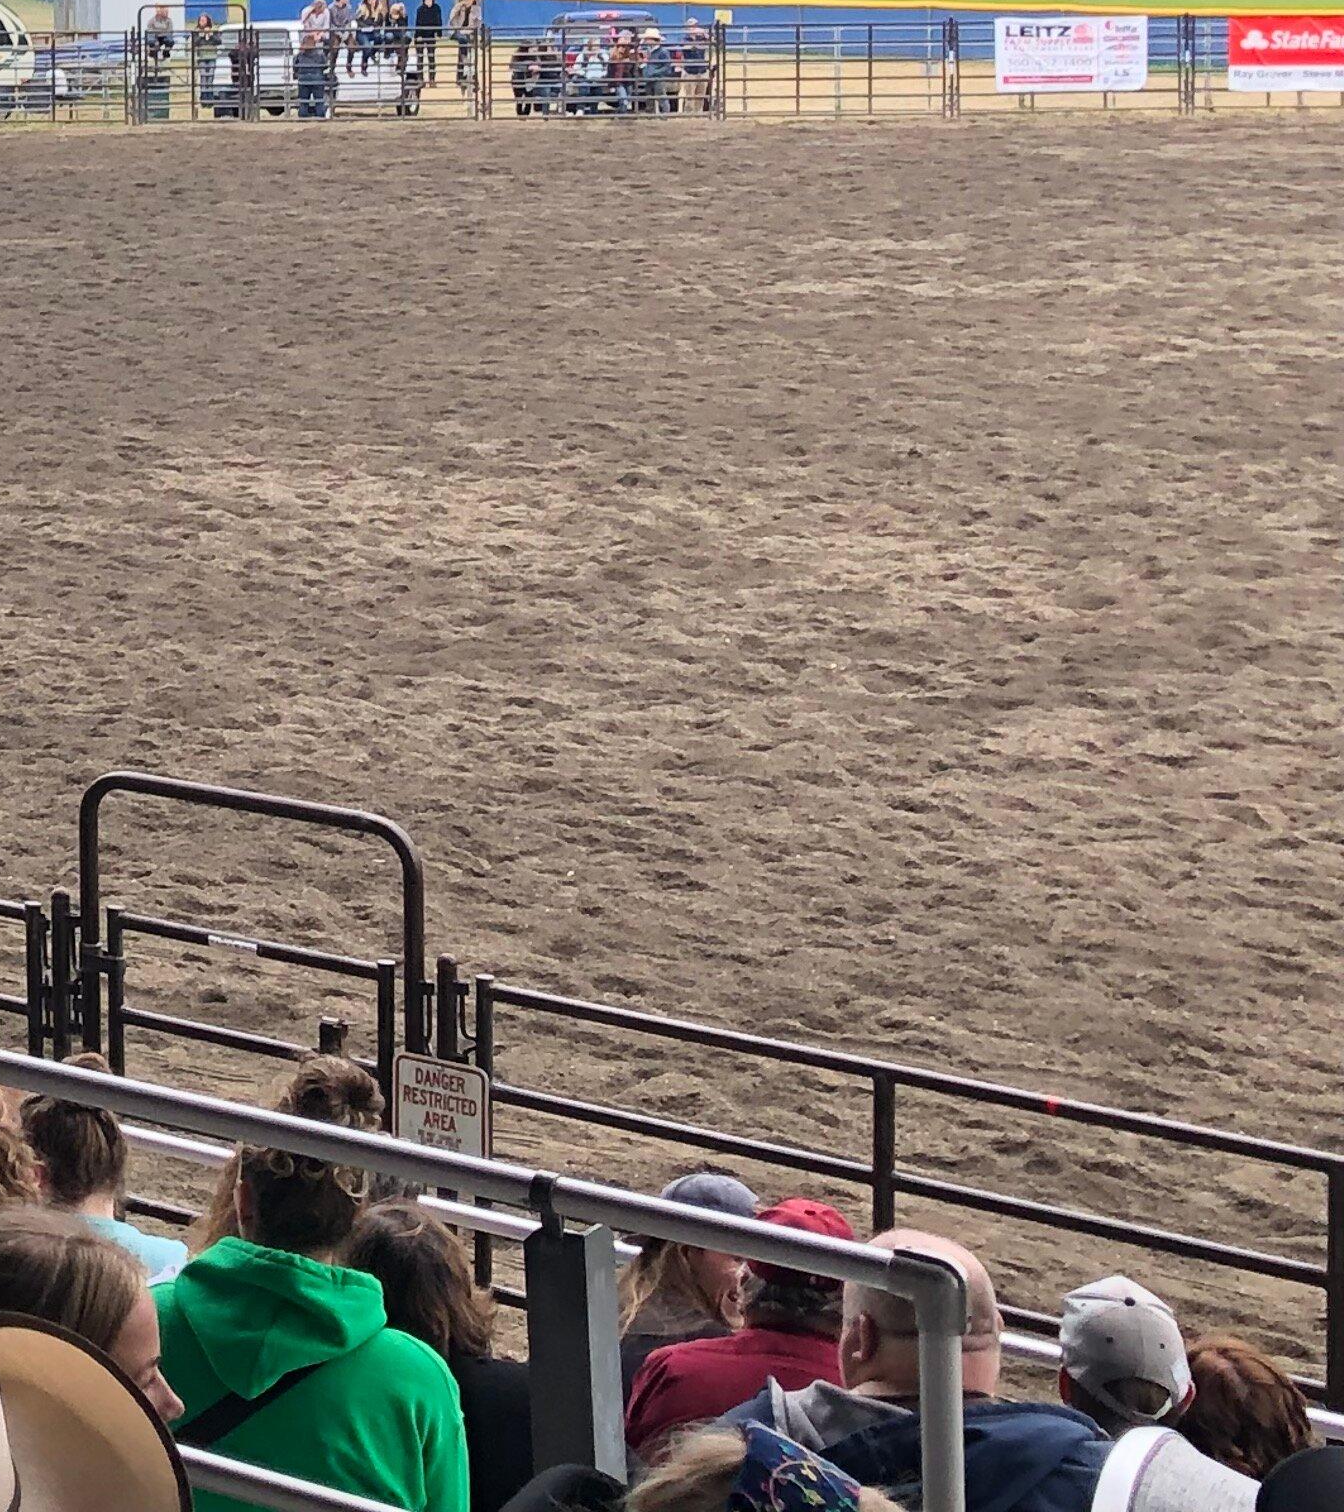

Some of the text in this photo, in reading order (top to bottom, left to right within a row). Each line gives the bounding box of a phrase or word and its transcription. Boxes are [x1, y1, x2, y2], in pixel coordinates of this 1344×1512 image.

[1005, 25, 1071, 38] LEITZ
[415, 1067, 466, 1094] DANGER
[402, 1084, 477, 1117] RESTRICTED
[423, 1110, 457, 1133] AREA
